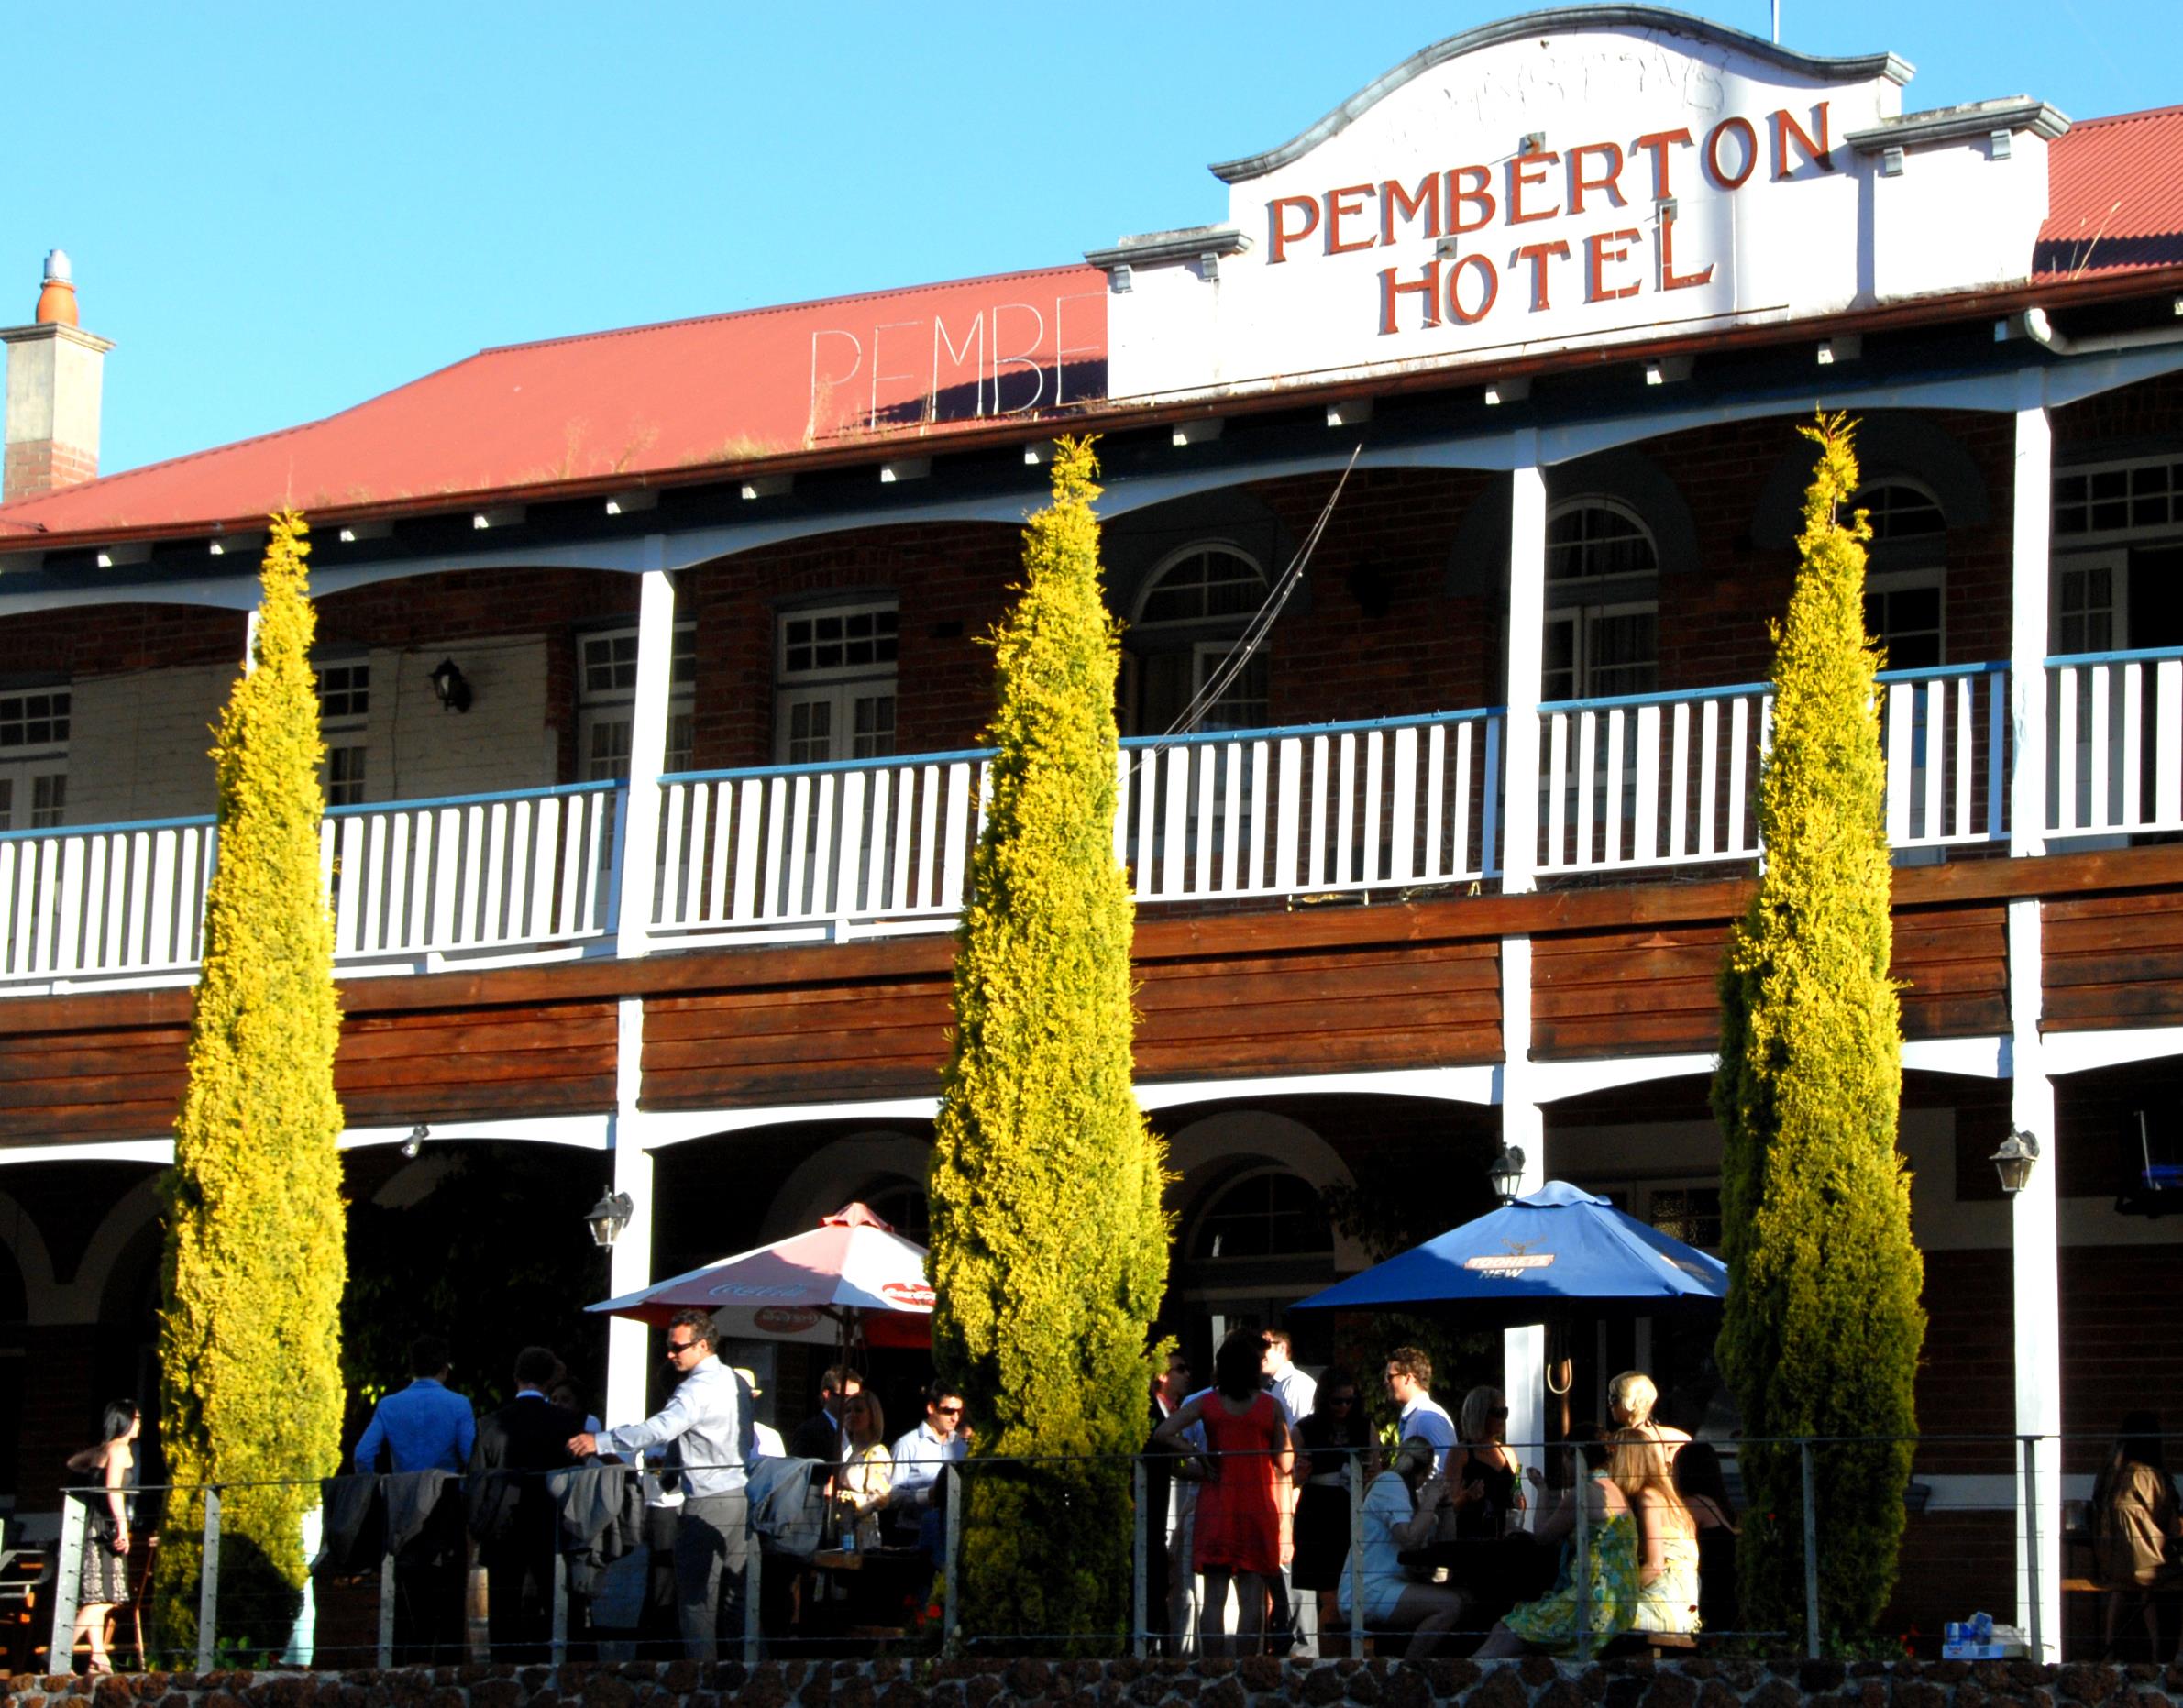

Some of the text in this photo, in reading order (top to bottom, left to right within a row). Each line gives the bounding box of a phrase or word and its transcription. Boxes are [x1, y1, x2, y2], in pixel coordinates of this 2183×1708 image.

[1268, 100, 1835, 263] PEMBERTON
[1380, 207, 1715, 336] HOTEL
[1479, 1269, 1524, 1279] NEW
